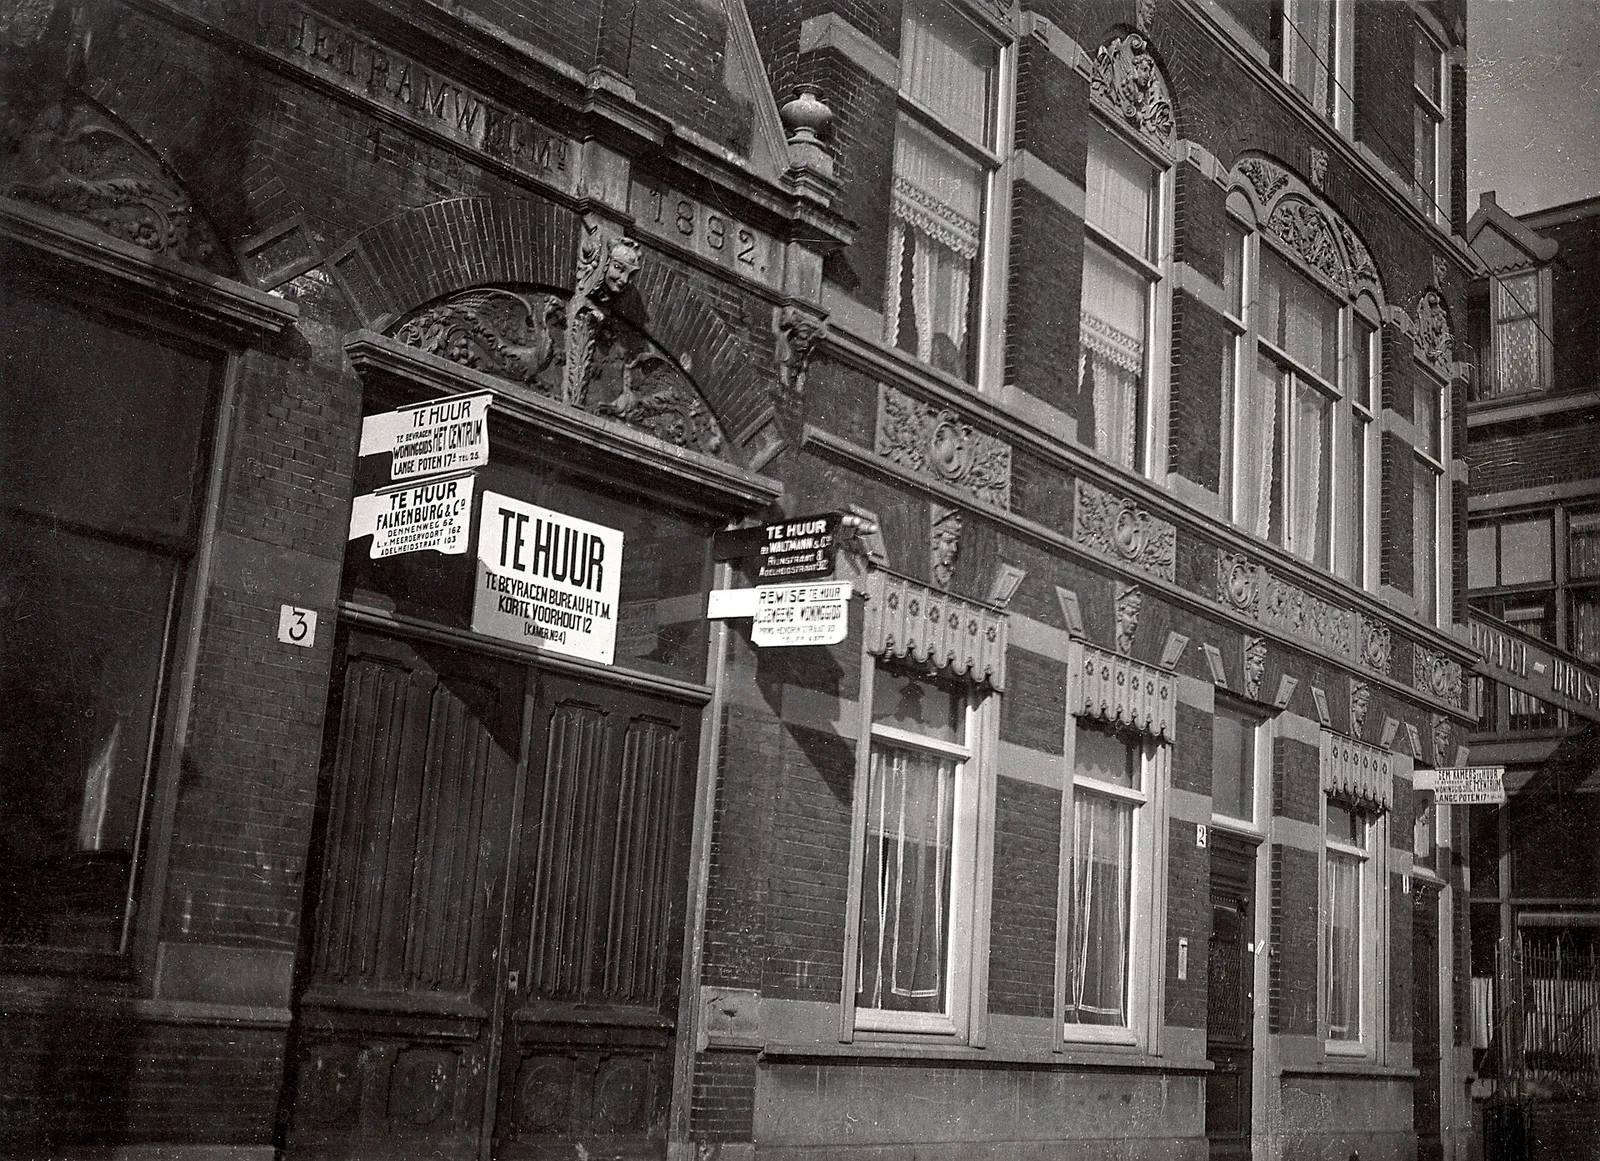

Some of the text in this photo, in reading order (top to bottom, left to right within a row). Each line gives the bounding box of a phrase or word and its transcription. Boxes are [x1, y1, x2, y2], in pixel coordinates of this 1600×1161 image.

[412, 400, 471, 428] TE HUUR
[396, 435, 404, 443] TE
[433, 419, 483, 453] HET CENTRUM
[393, 457, 416, 476] LANGE
[418, 455, 442, 472] POTEN
[389, 481, 458, 511] TE HUUR
[376, 502, 444, 531] FALKENBURG
[444, 504, 451, 517] &
[387, 518, 454, 538] DENNENWEG 62
[448, 525, 462, 534] 162
[766, 519, 828, 540] TE HUUR
[380, 535, 457, 557] ADELHEIDSTRAAT 103
[498, 507, 605, 593] TE HUUR
[485, 571, 498, 591] TE
[549, 588, 587, 613] BUREAU
[758, 586, 841, 605] REMISE TE HUUR
[288, 610, 308, 641] 3
[497, 594, 593, 634] KORTE VOORHOUT 12
[1467, 620, 1529, 680] HOTEL
[1434, 794, 1458, 802] LANGE
[1458, 793, 1480, 802] POTEN
[1199, 826, 1205, 845] 2
